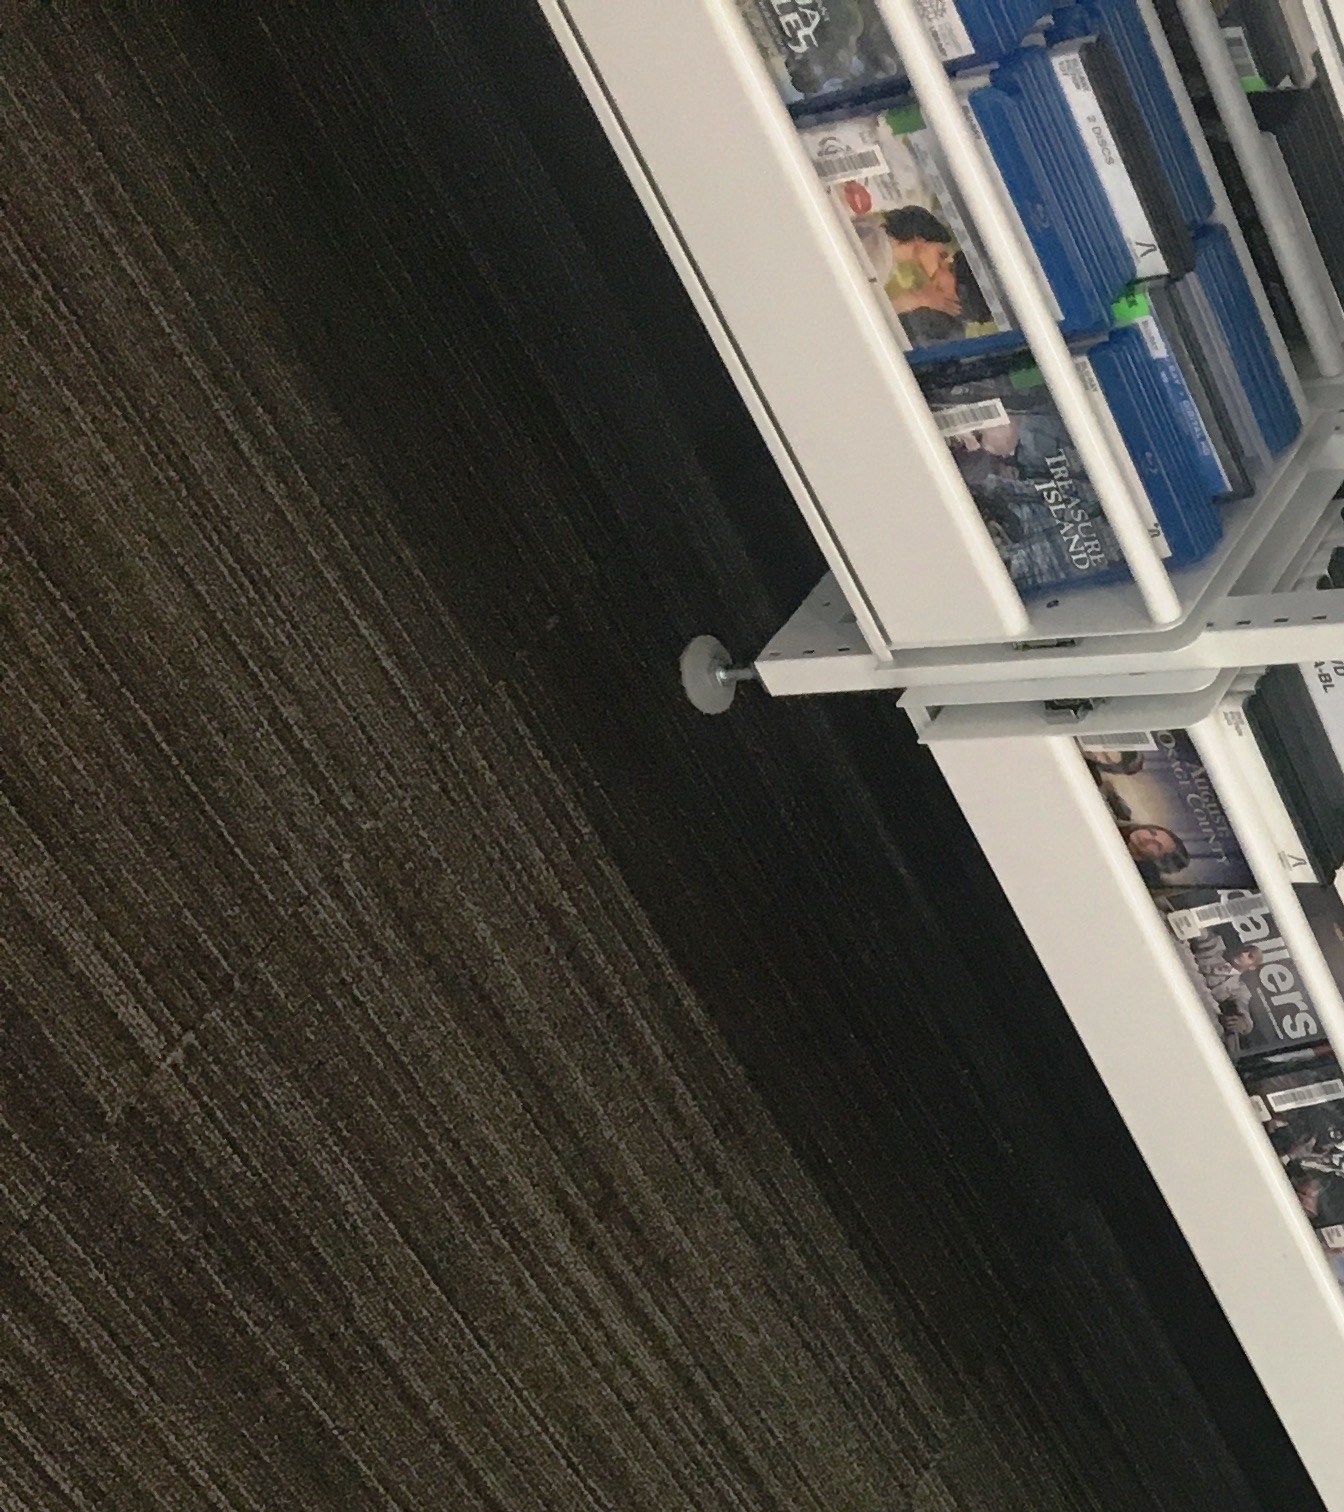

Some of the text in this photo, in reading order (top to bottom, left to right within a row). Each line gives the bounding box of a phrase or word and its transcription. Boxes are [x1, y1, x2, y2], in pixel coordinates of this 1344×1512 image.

[1086, 115, 1115, 166] 2 DISCS
[1033, 478, 1091, 571] ISLAND
[1044, 448, 1107, 568] TREASURE
[1155, 731, 1230, 868] OSAGE COUNTY
[1216, 889, 1318, 1040] allers
